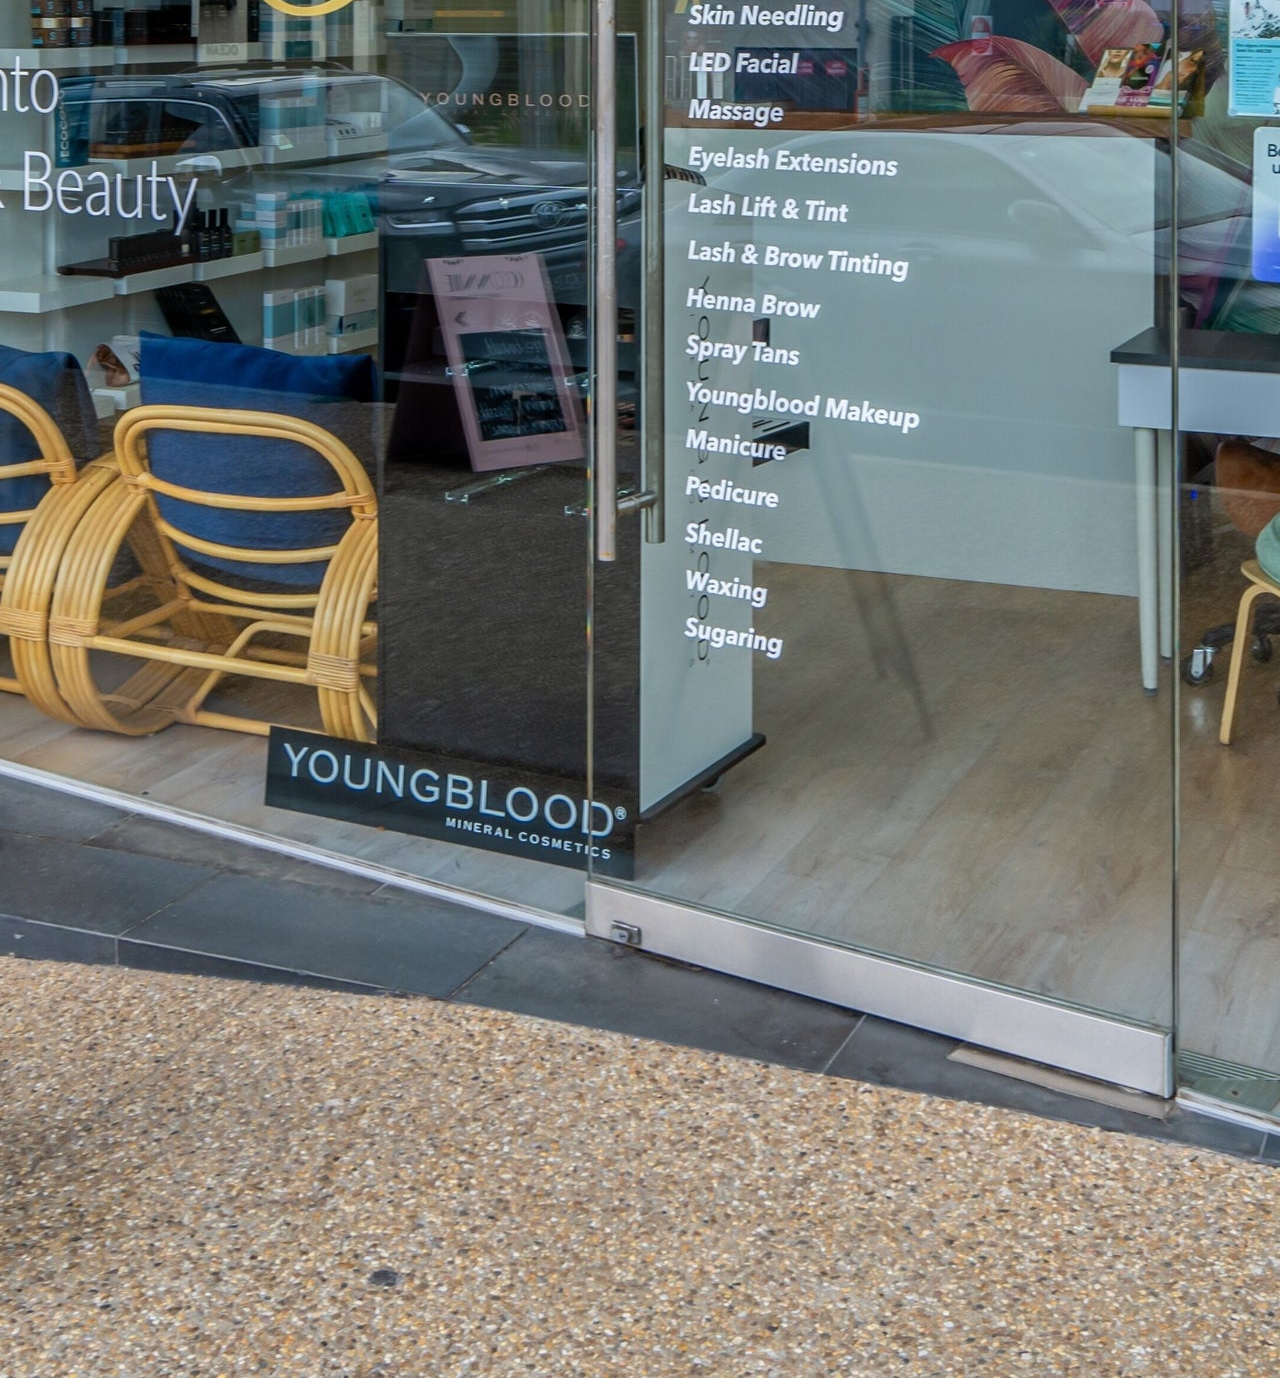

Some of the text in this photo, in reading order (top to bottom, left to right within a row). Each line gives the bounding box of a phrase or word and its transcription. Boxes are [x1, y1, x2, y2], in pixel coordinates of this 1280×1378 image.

[687, 3, 844, 32] Skin Needling
[688, 51, 732, 72] LED
[735, 52, 800, 75] Facial
[420, 92, 590, 108] YOUNGBLOOD
[688, 98, 784, 128] Massage
[687, 145, 899, 177] Eyelash Extensions
[23, 150, 199, 237] Beauty
[687, 192, 849, 223] Lash Lift & Tint
[687, 239, 910, 283] Lash & Brow Tinting
[685, 287, 822, 319] Henna Brow
[685, 333, 801, 366] Spray Tans
[686, 381, 921, 434] Youngblood Makeup
[685, 428, 787, 461] Manicure
[685, 475, 780, 509] Pedicure
[684, 522, 764, 554] Shellac
[685, 569, 769, 608] Waxing
[683, 617, 784, 660] Sugaring
[445, 816, 612, 861] MINERAL COSMETICS
